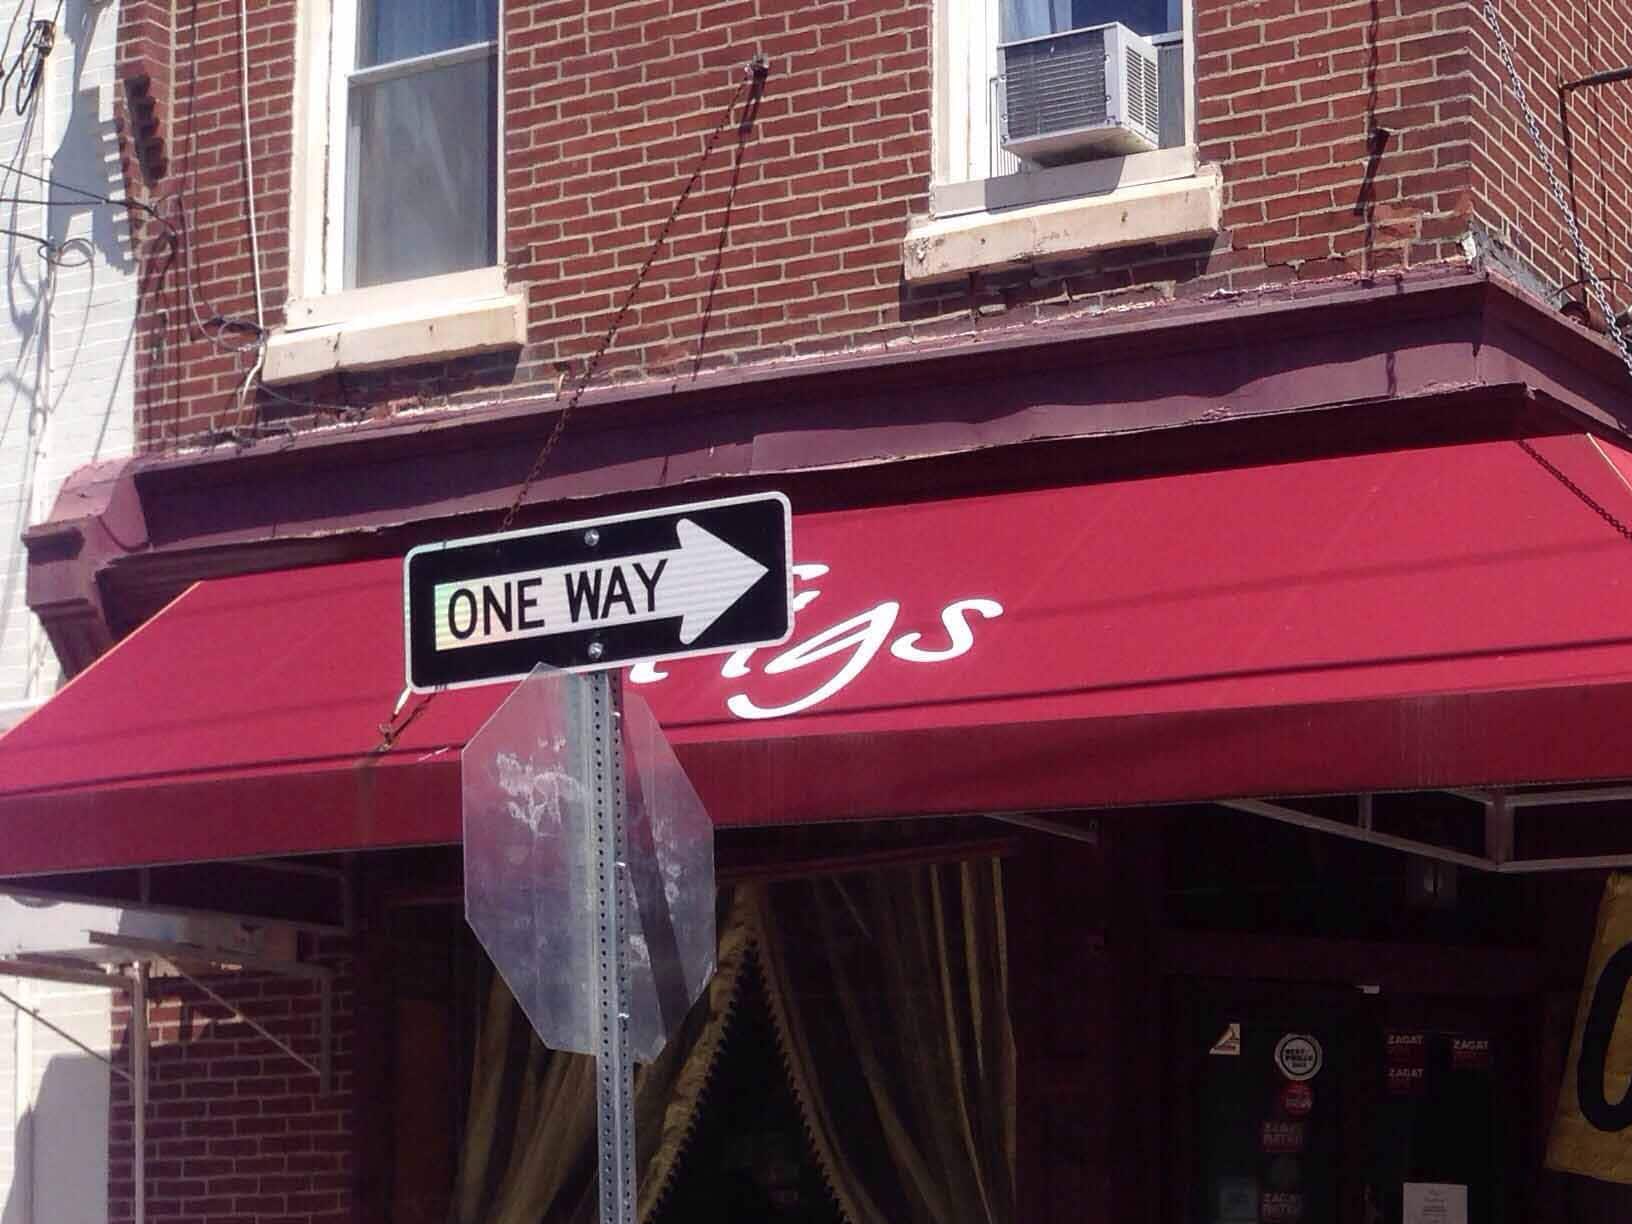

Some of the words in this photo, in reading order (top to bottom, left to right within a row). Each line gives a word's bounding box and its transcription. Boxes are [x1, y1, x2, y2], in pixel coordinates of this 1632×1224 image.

[447, 576, 545, 640] ONE
[564, 557, 669, 622] WAY
[1387, 1033, 1424, 1046] ZAGAT
[1452, 1040, 1489, 1050] ZAGAT
[1387, 1066, 1424, 1079] ZAGAT
